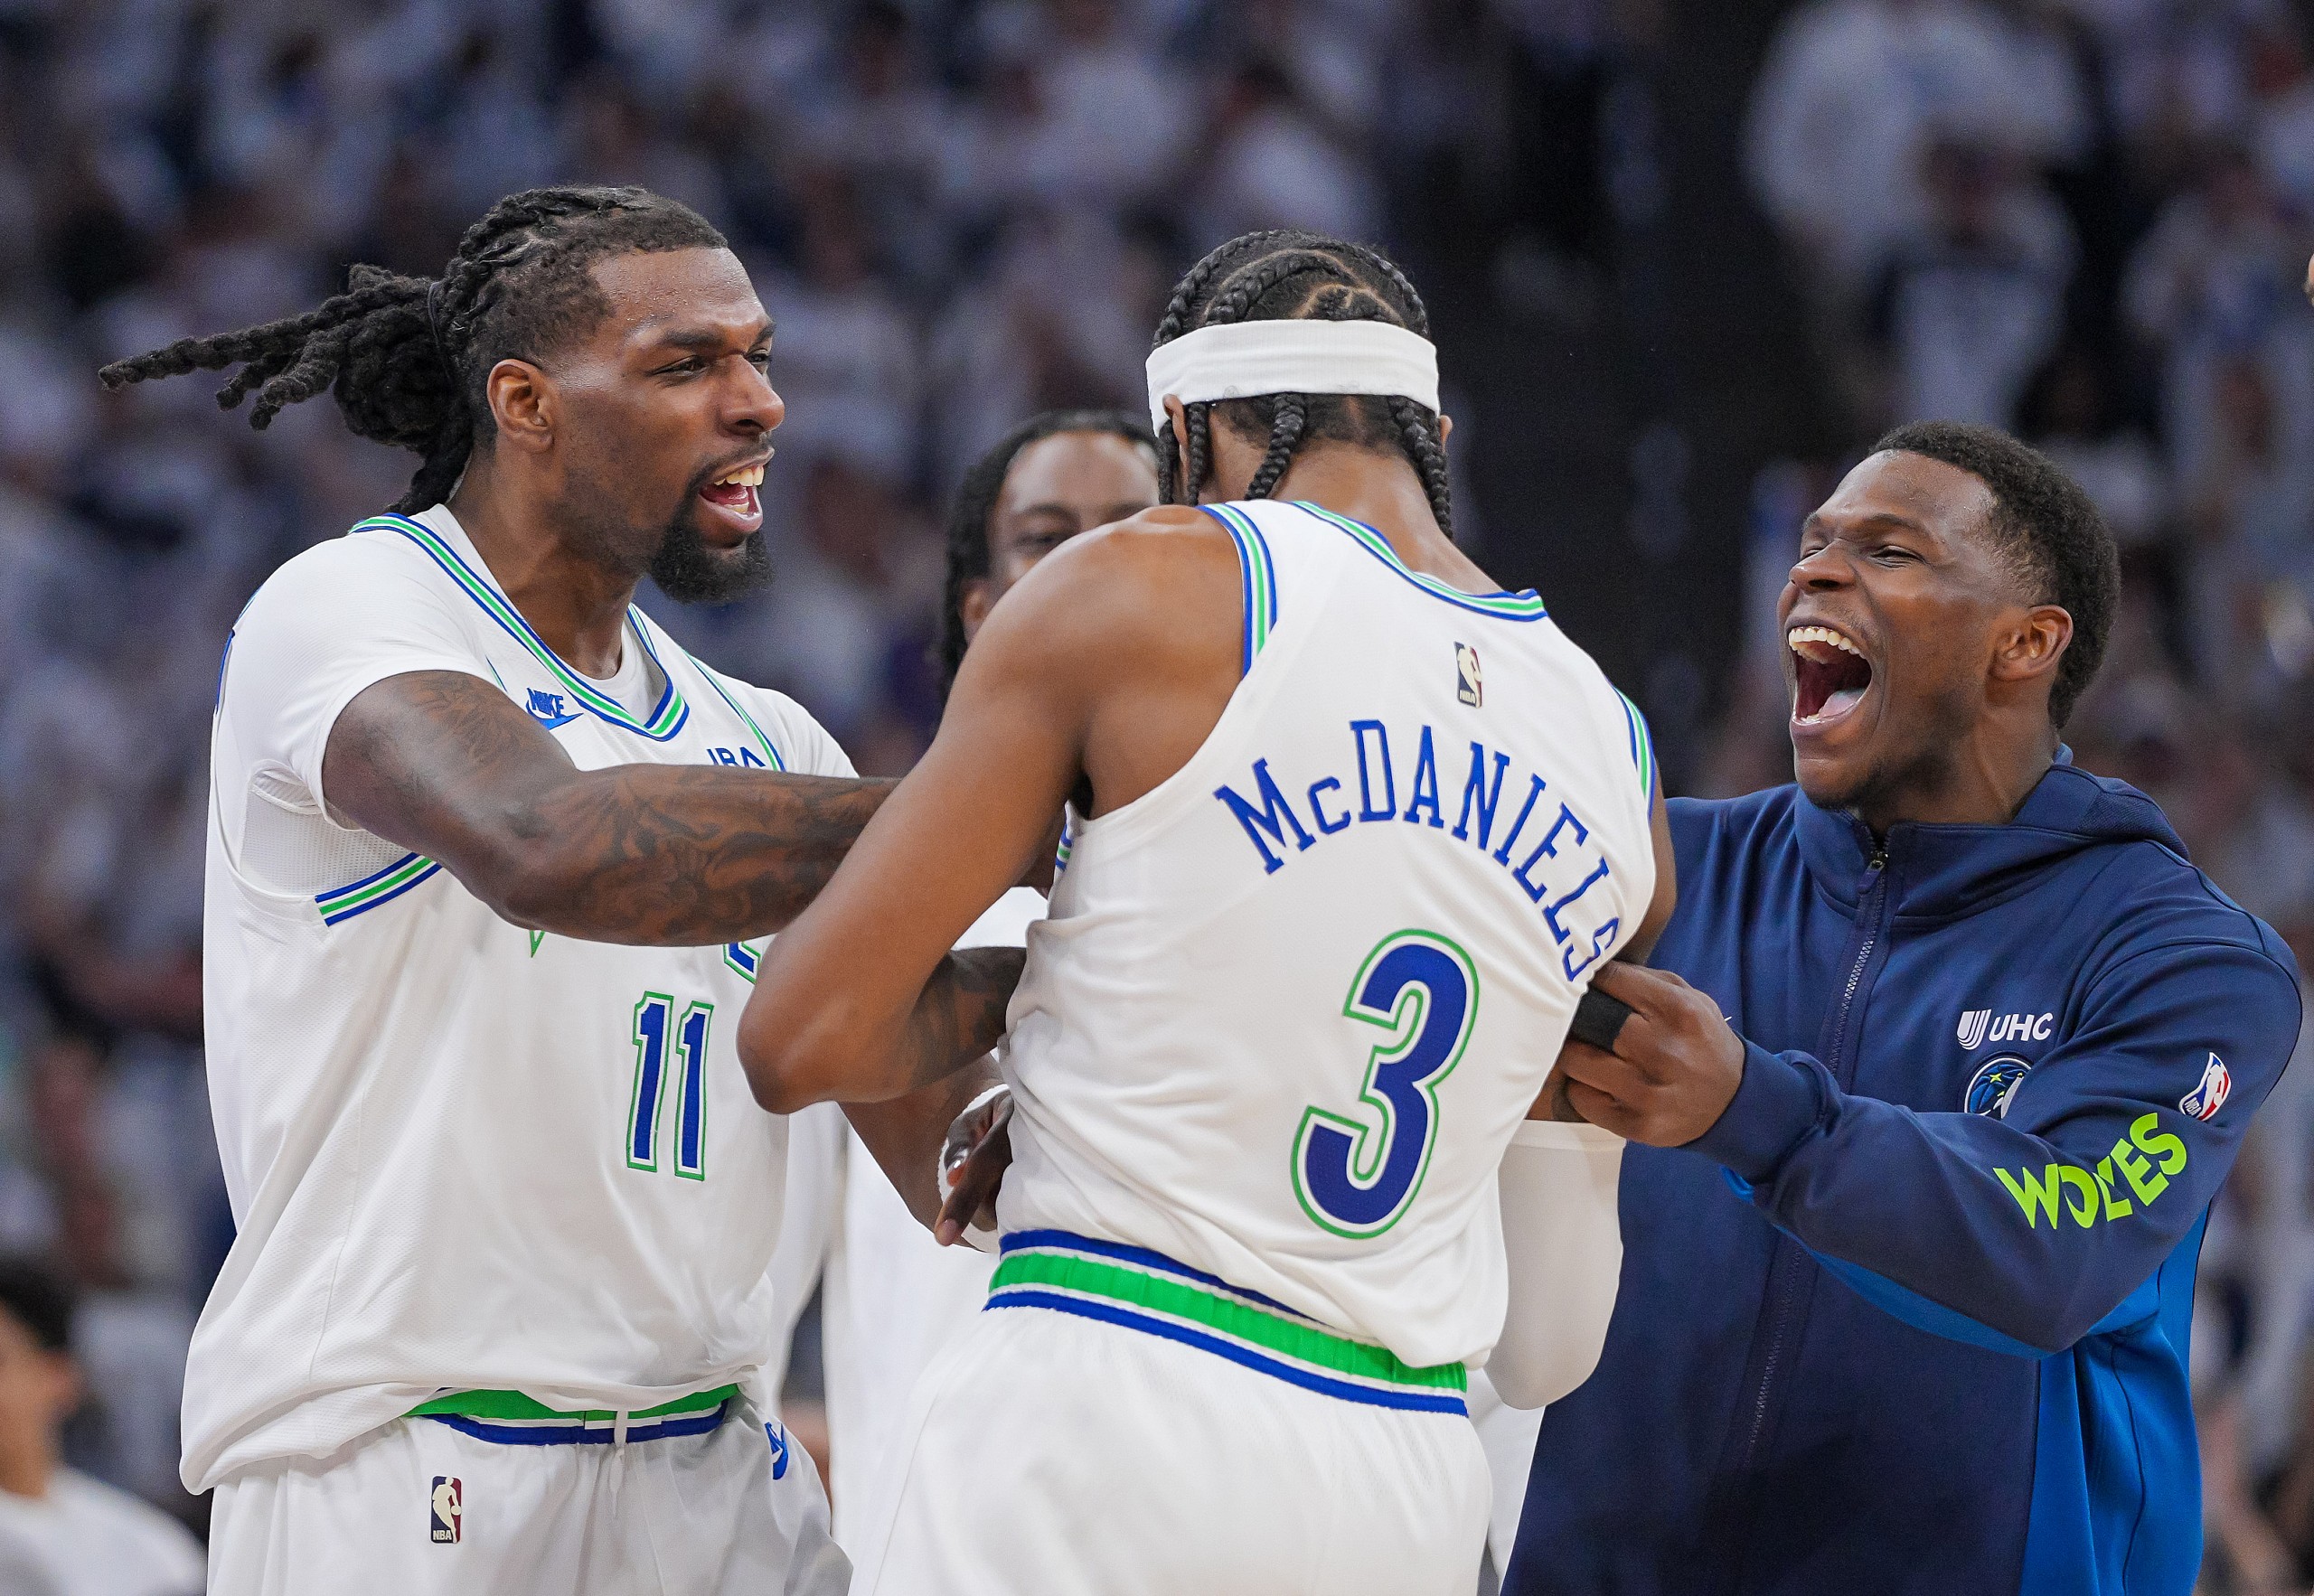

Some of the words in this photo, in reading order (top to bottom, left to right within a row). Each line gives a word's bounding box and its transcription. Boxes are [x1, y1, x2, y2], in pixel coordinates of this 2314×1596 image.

[526, 687, 567, 718] NIKE
[1459, 690, 1476, 704] NBA
[1212, 718, 1620, 982] McDANIELS
[1989, 1011, 2054, 1042] UHC
[626, 990, 714, 1181] 11
[1290, 928, 1479, 1240] 3
[433, 1529, 452, 1541] NBA
